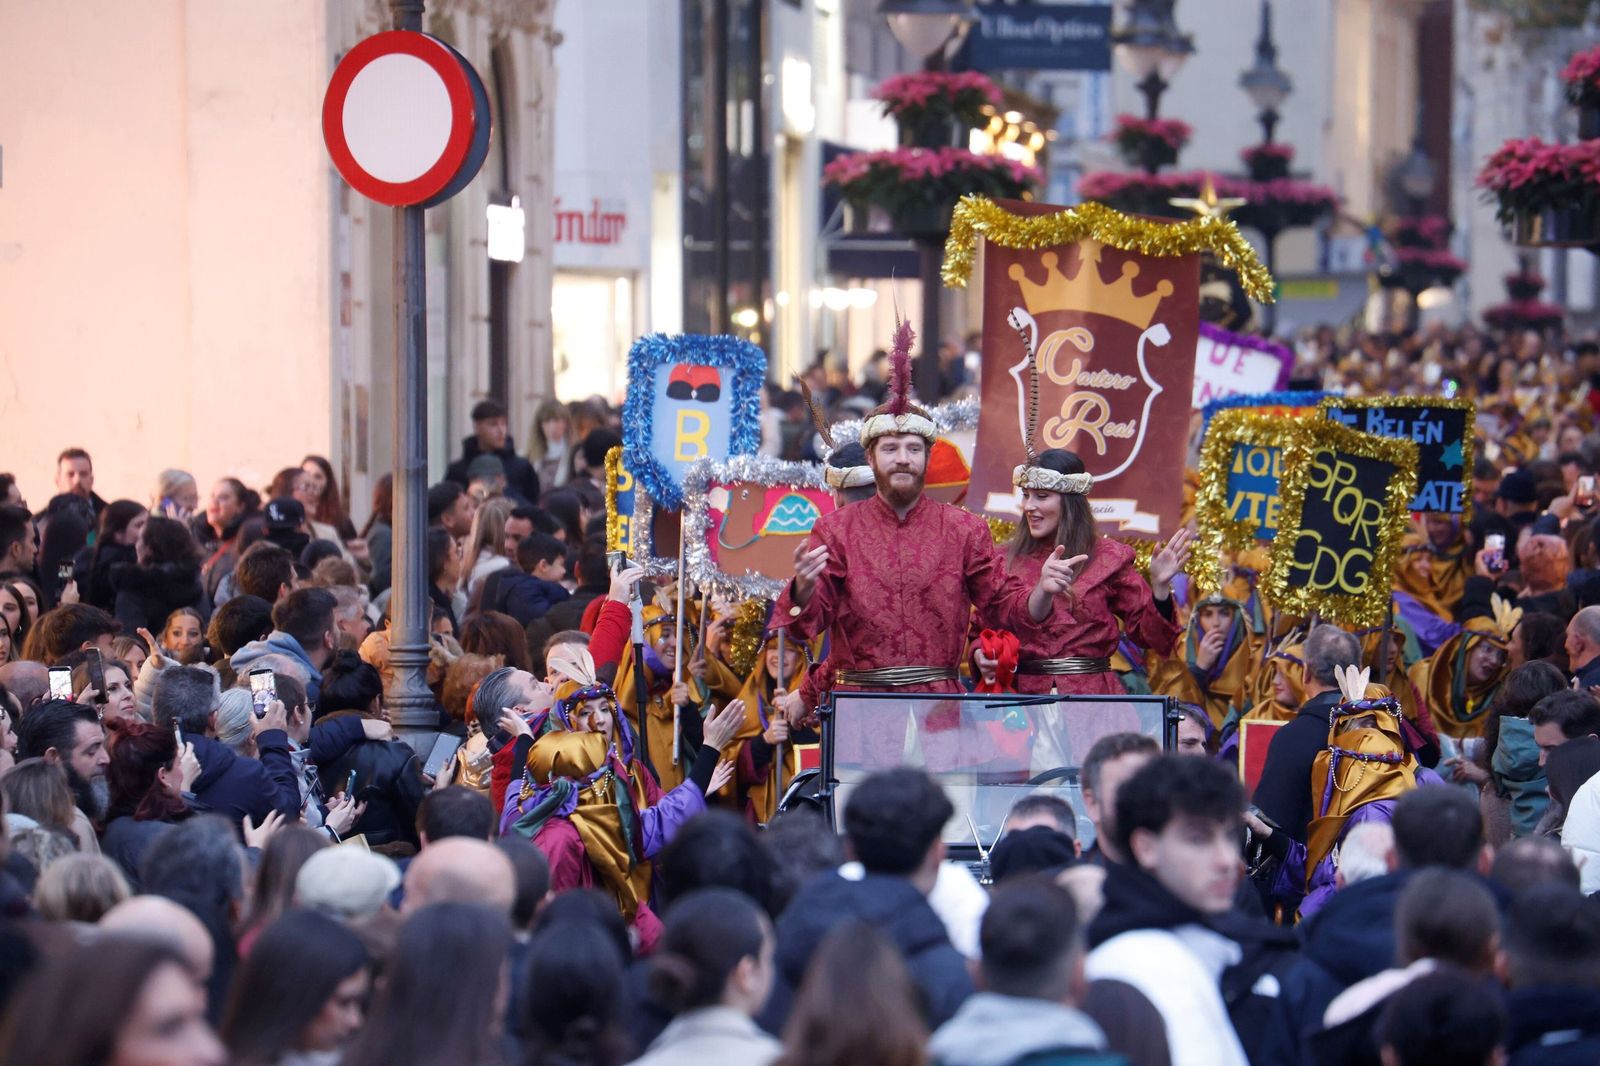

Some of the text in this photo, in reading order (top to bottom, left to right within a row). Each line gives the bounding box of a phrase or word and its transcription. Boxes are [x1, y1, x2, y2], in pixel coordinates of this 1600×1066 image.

[1035, 326, 1137, 390] Cartero
[674, 409, 711, 462] B
[1043, 391, 1136, 455] Real
[1309, 446, 1384, 548] SPQR
[1407, 480, 1464, 512] ATE
[1293, 529, 1373, 594] CDG
